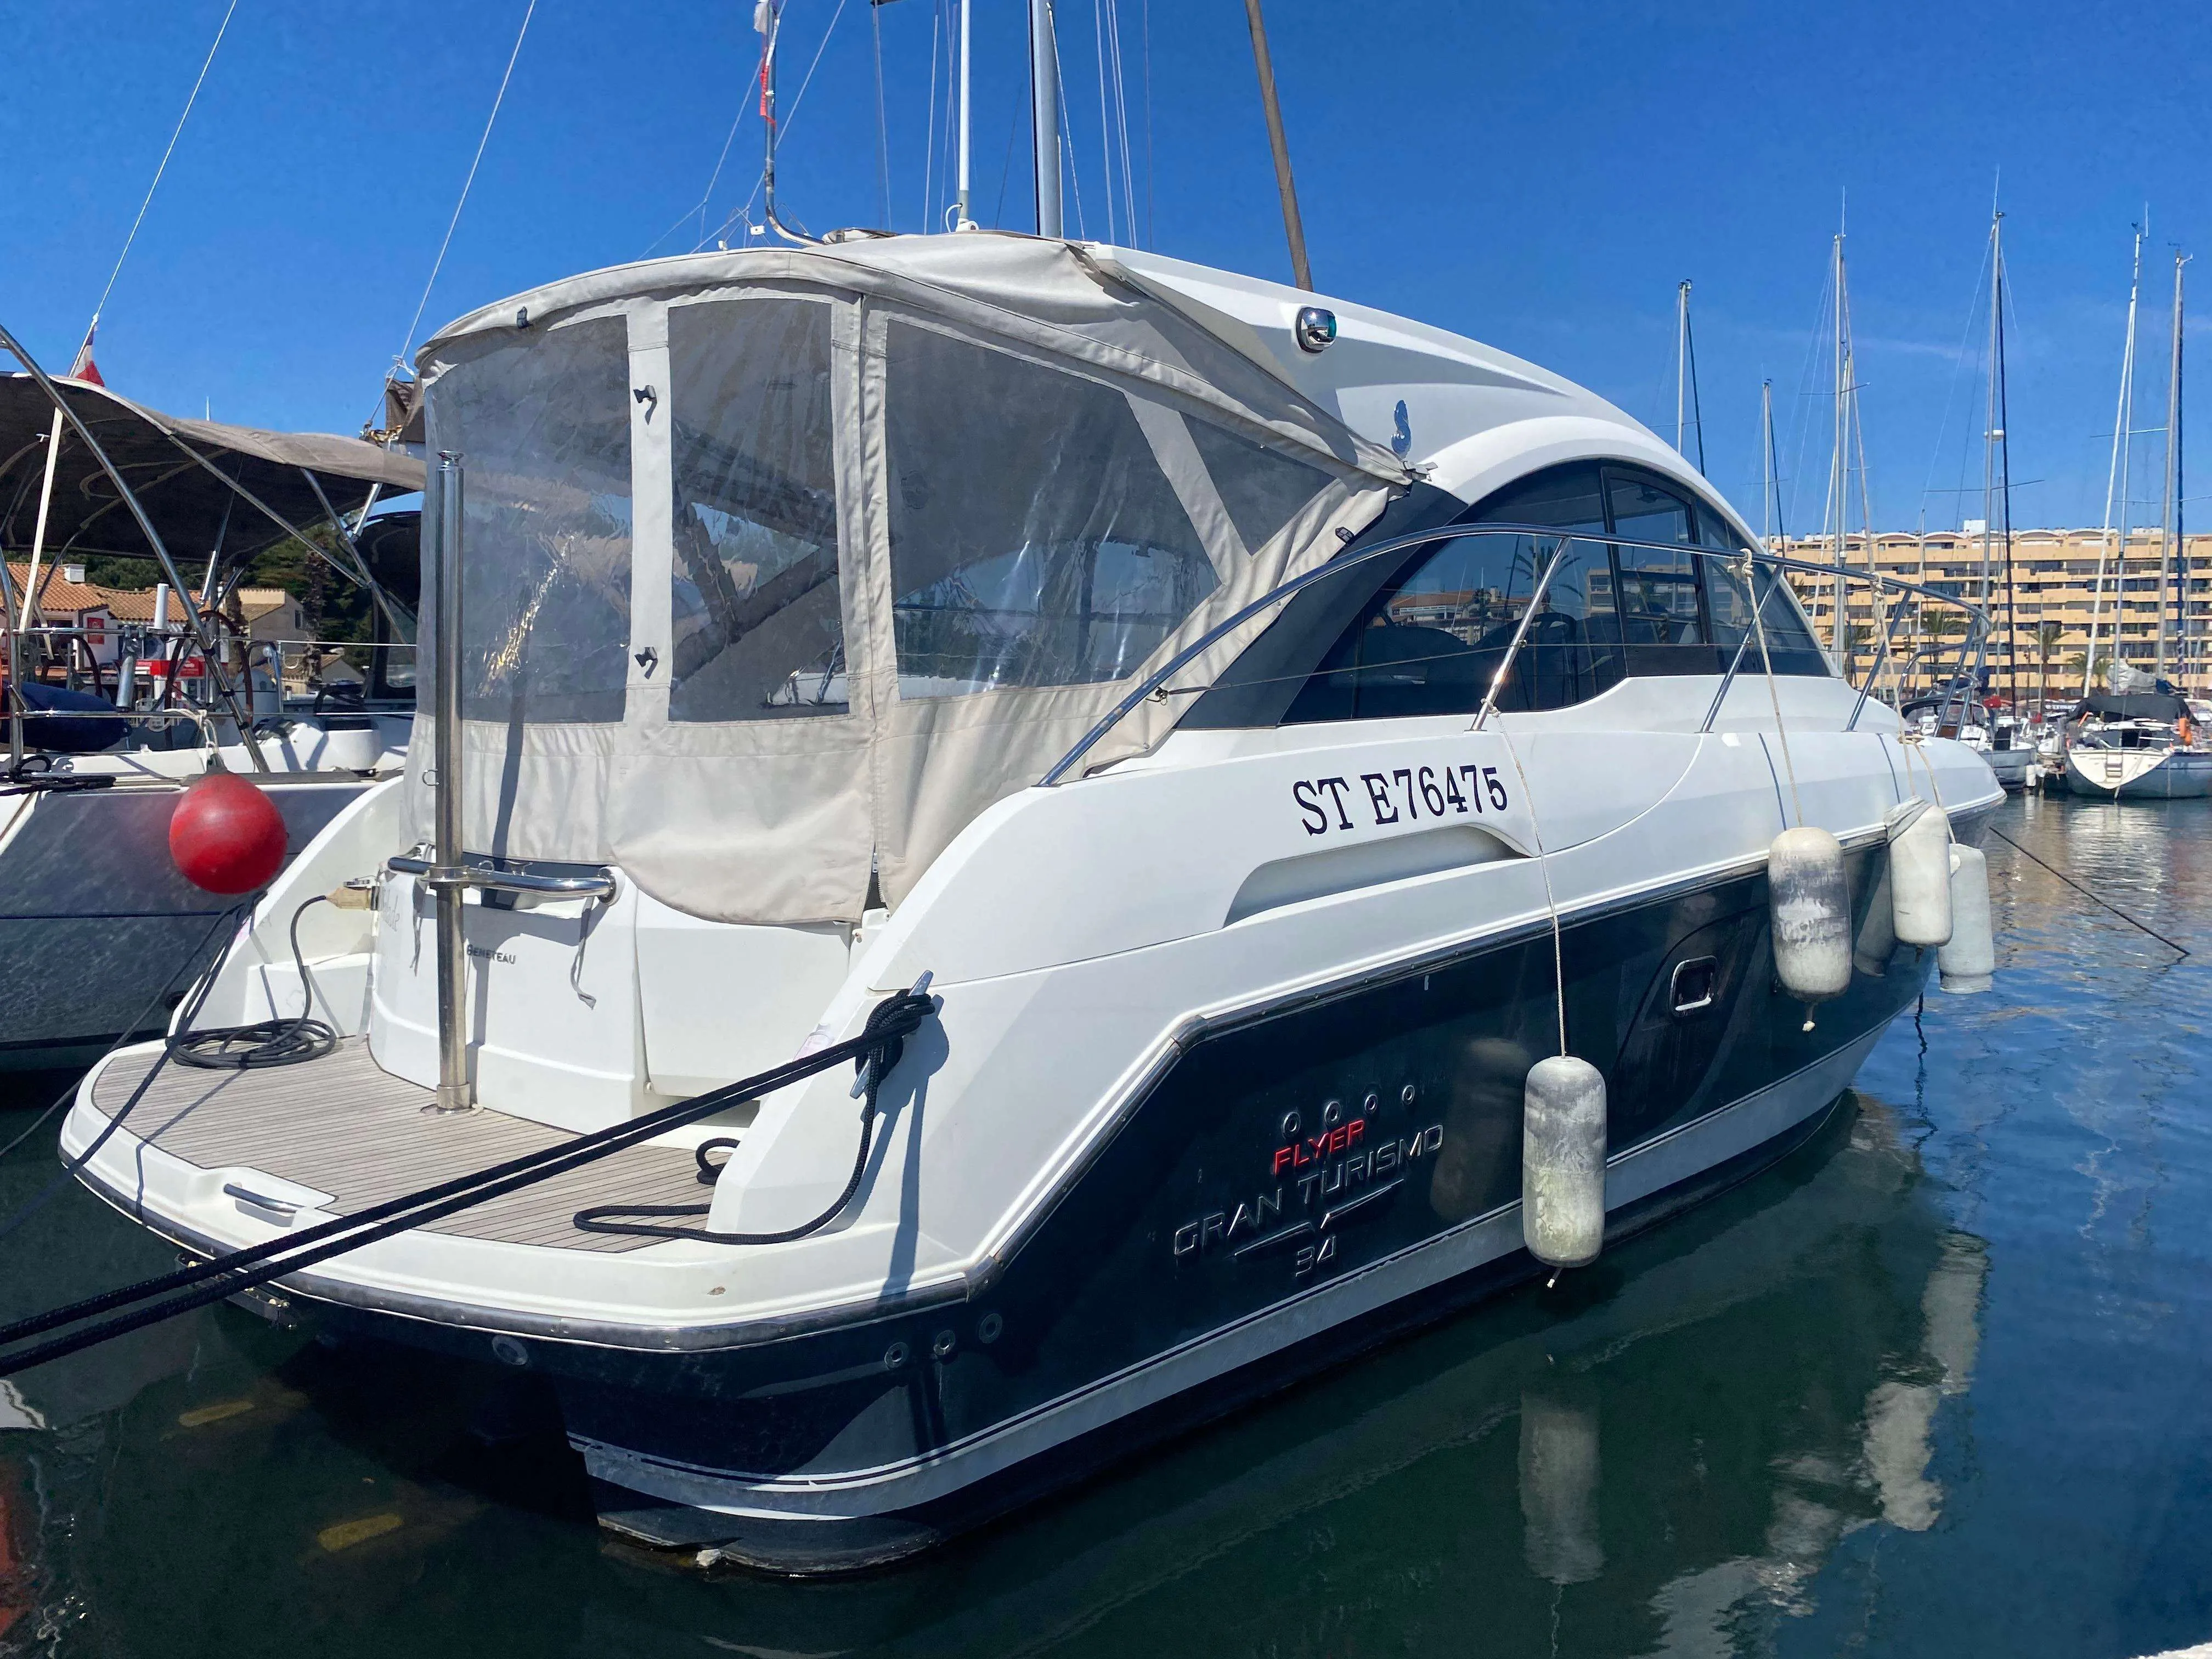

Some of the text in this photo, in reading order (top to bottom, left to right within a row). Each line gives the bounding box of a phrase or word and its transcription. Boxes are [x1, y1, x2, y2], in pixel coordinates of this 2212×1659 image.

[1293, 764, 1508, 837] ST E76475
[467, 944, 516, 964] BENETEAU
[1273, 1119, 1366, 1176] FLYER
[1173, 1124, 1444, 1256] GRAN TURISMO
[1295, 1235, 1337, 1278] 34
